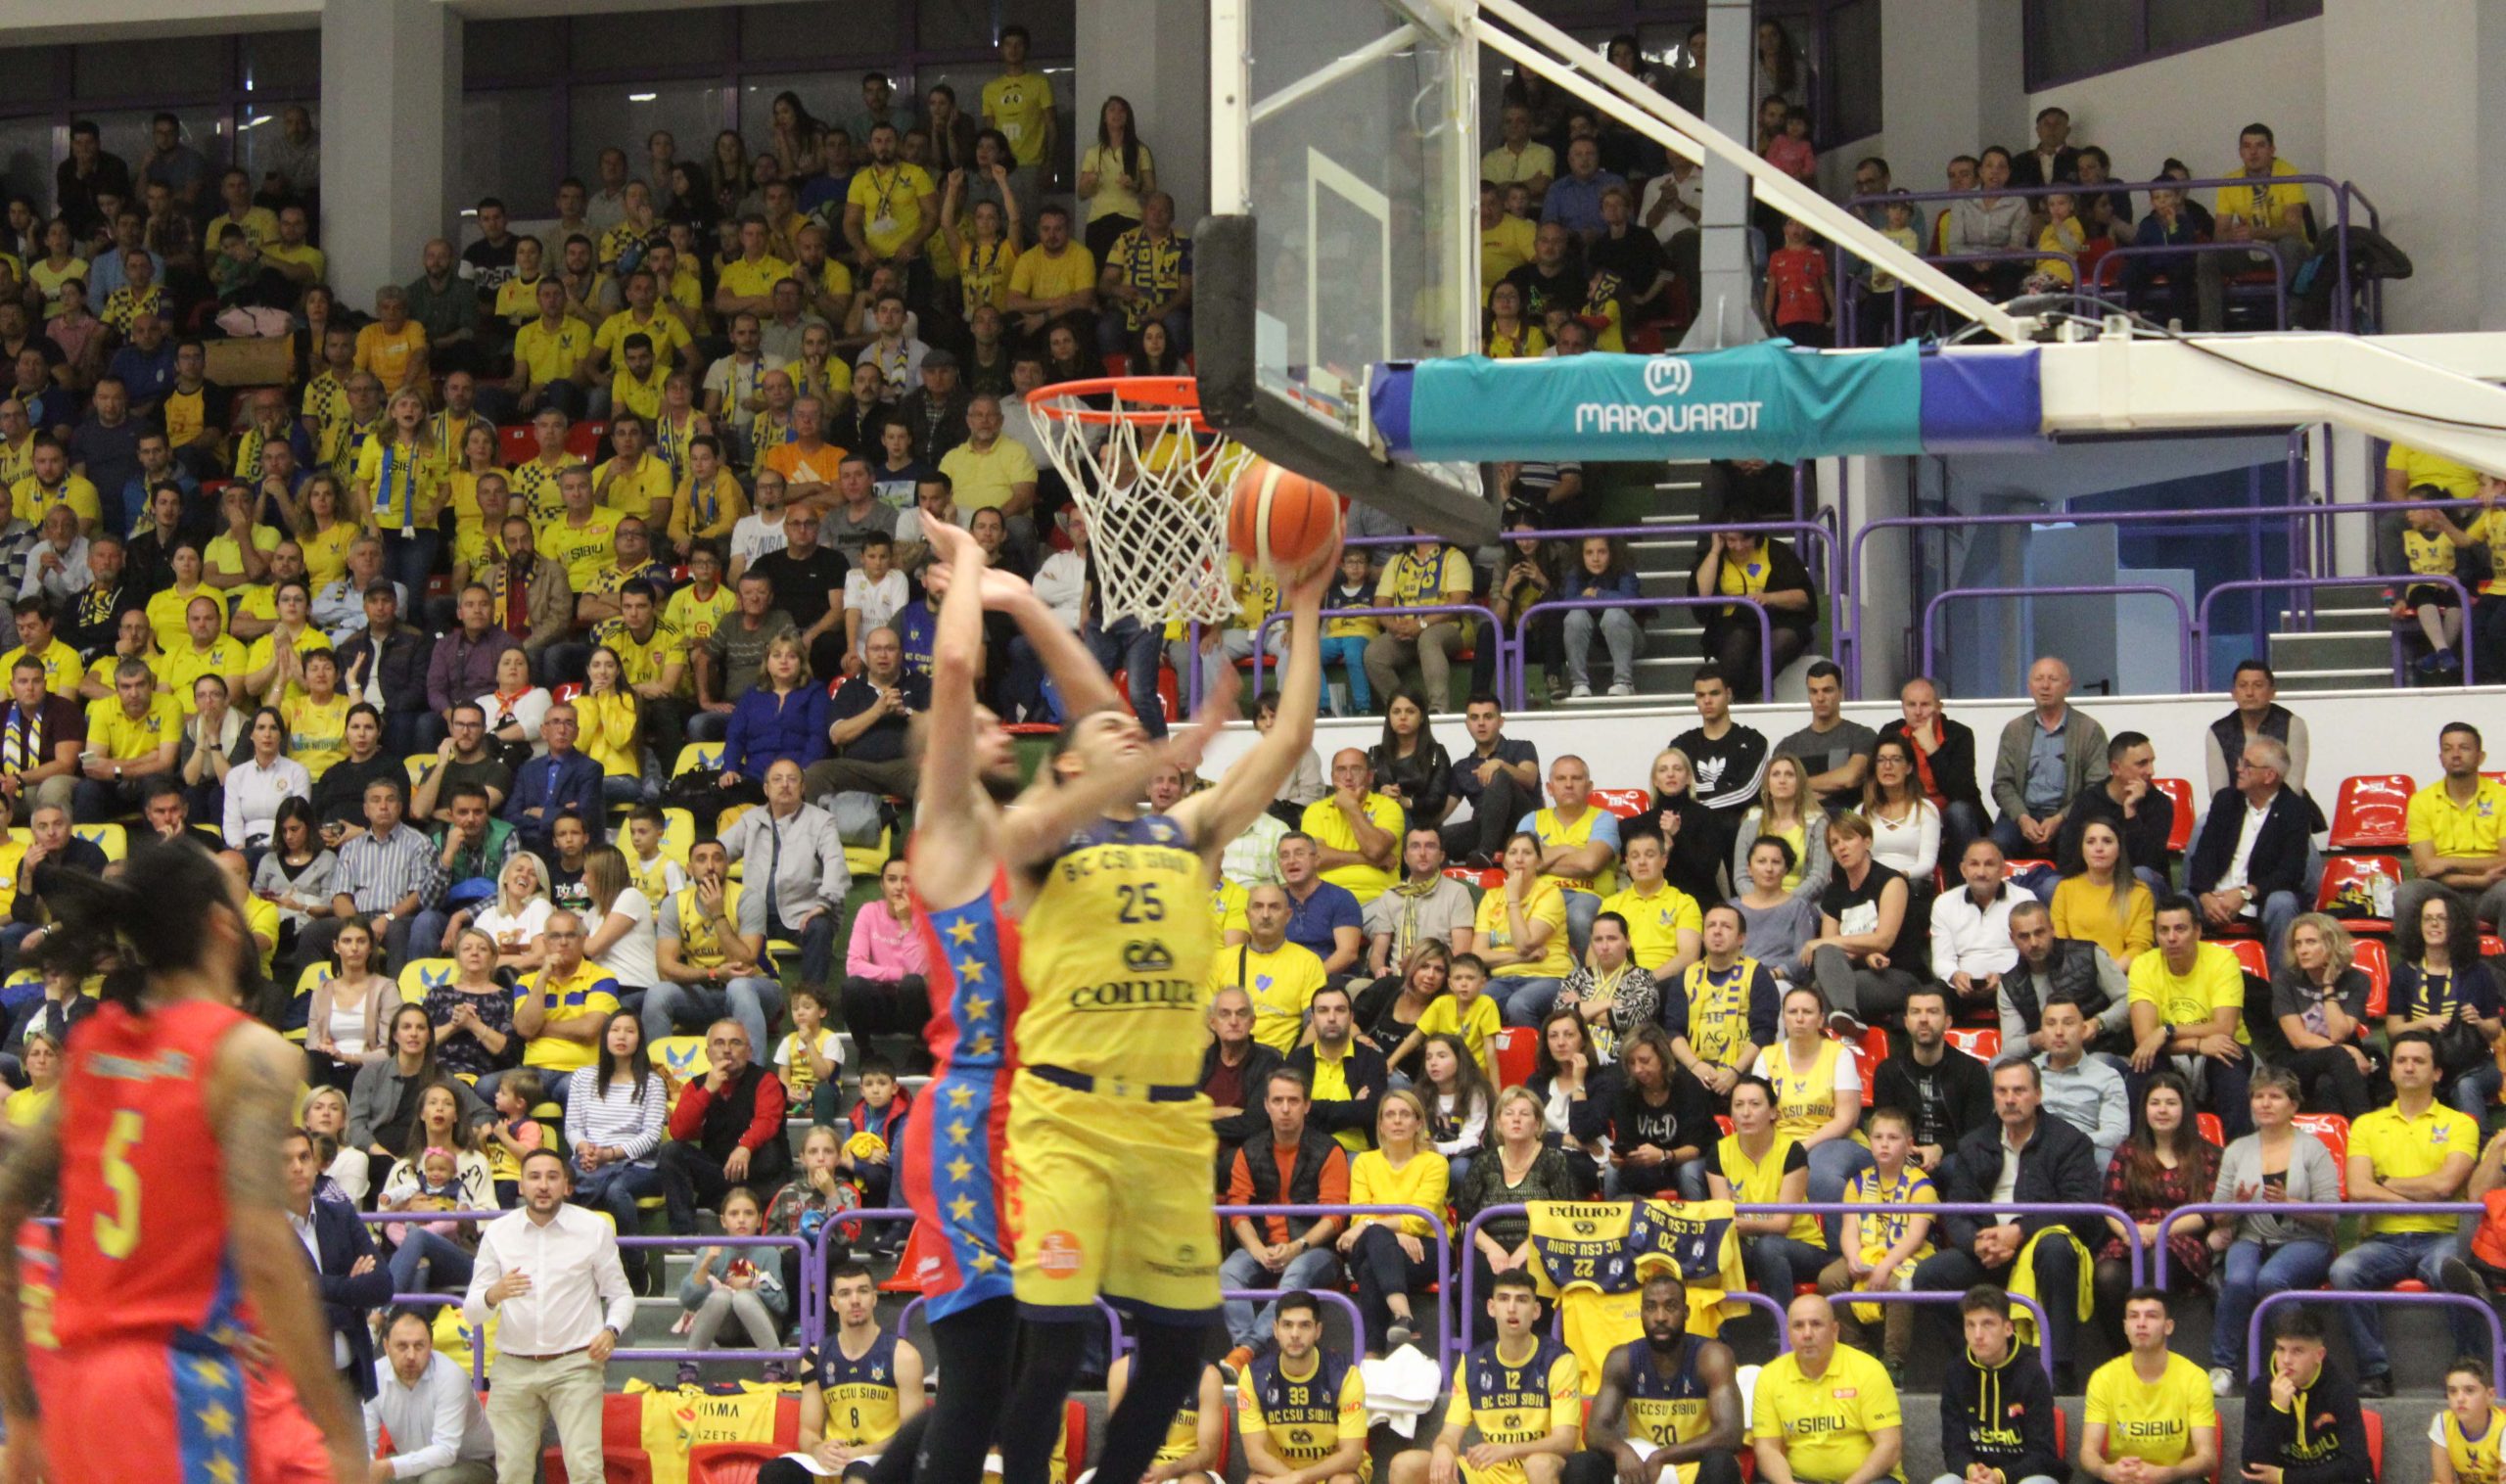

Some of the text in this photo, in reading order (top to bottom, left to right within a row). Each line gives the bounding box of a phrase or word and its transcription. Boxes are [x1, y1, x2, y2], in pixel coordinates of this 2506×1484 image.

[1575, 401, 1763, 434] MARQUARDT
[571, 543, 603, 560] SIBIU
[758, 534, 783, 557] NBA
[1118, 882, 1165, 923] 25
[1071, 980, 1197, 1009] comp
[1783, 1106, 1802, 1119] CSU
[93, 1110, 145, 1260] 5
[1549, 1205, 1622, 1219] compa
[1668, 1222, 1688, 1233] CSU
[1547, 1239, 1622, 1255] BC CSU SIBIU
[1658, 1233, 1678, 1253] 20
[1572, 1259, 1596, 1276] 22
[1505, 1371, 1521, 1389] 12
[840, 1388, 858, 1400] CSU
[859, 1386, 889, 1400] SIBIU
[1288, 1386, 1310, 1406] 33
[1481, 1396, 1494, 1410] BC
[1497, 1393, 1517, 1408] CSU
[850, 1408, 859, 1429] 8
[1268, 1411, 1281, 1423] BC
[1282, 1409, 1304, 1421] CSU
[1647, 1404, 1668, 1416] CSU
[1672, 1403, 1697, 1416] SIBIU
[1798, 1414, 1846, 1434] SIBIU
[2130, 1418, 2183, 1436] SIBIU
[1651, 1424, 1678, 1447] 20
